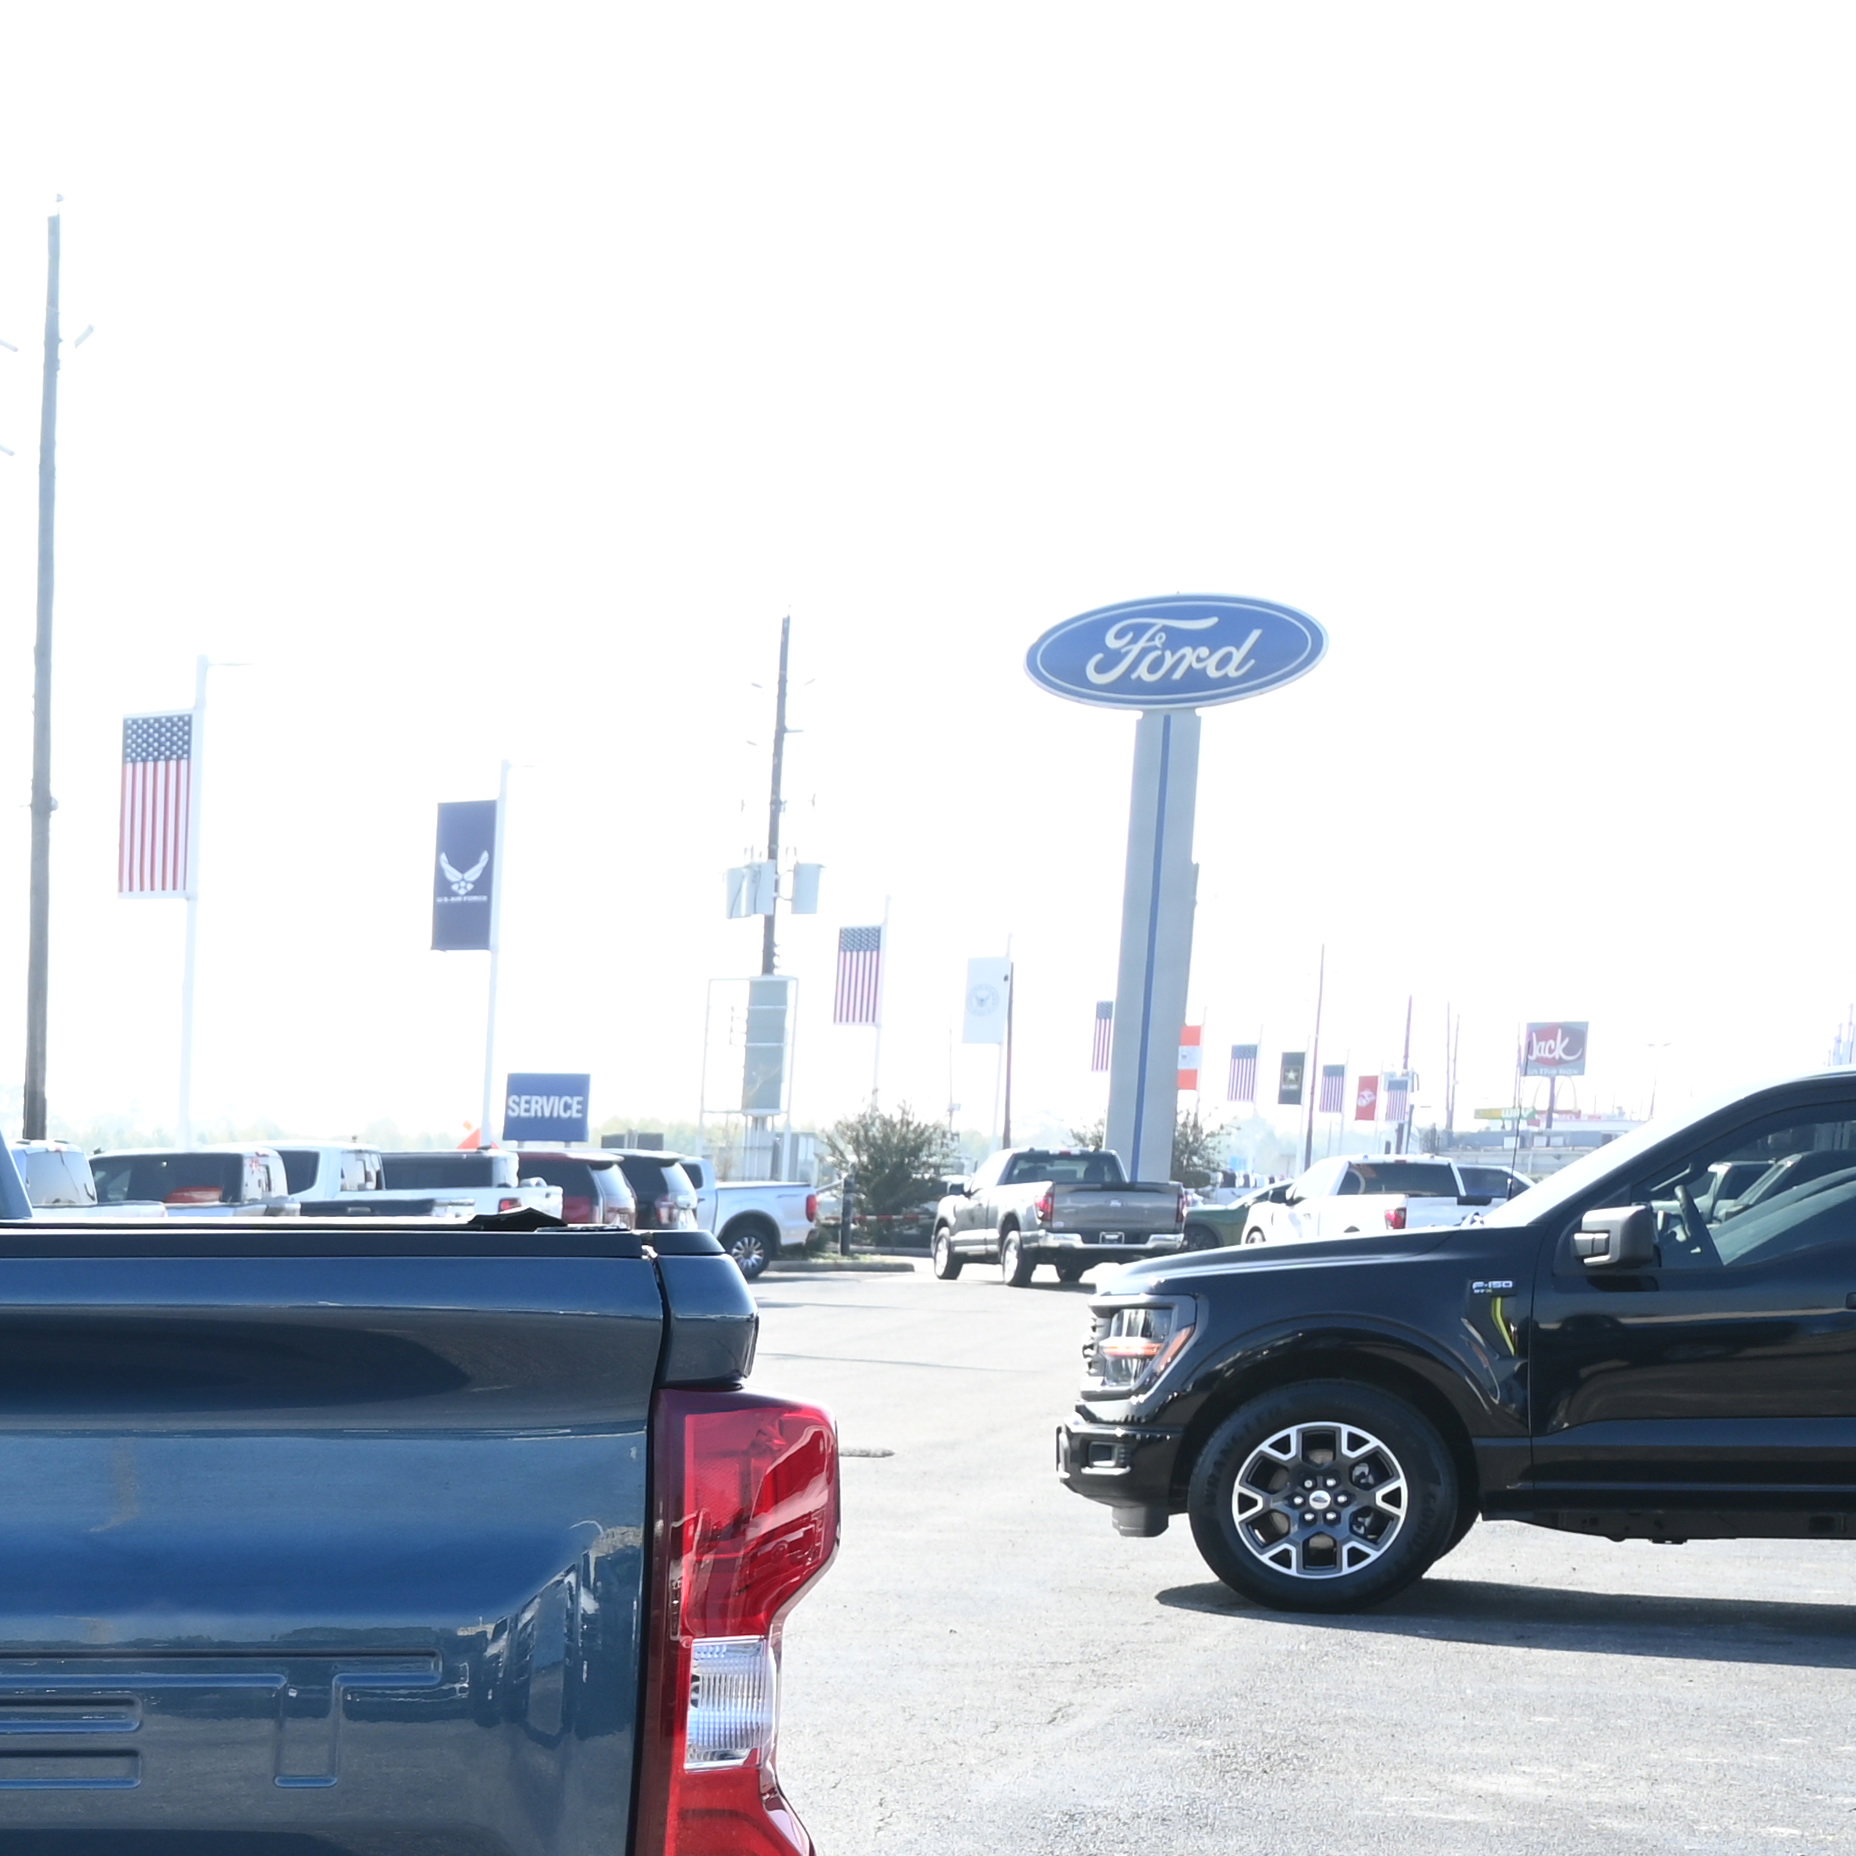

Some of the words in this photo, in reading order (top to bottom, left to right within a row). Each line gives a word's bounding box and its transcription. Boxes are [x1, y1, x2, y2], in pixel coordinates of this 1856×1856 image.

[1086, 616, 1263, 685] Ford
[1528, 1028, 1583, 1061] Jack
[508, 1094, 584, 1118] SERVICE
